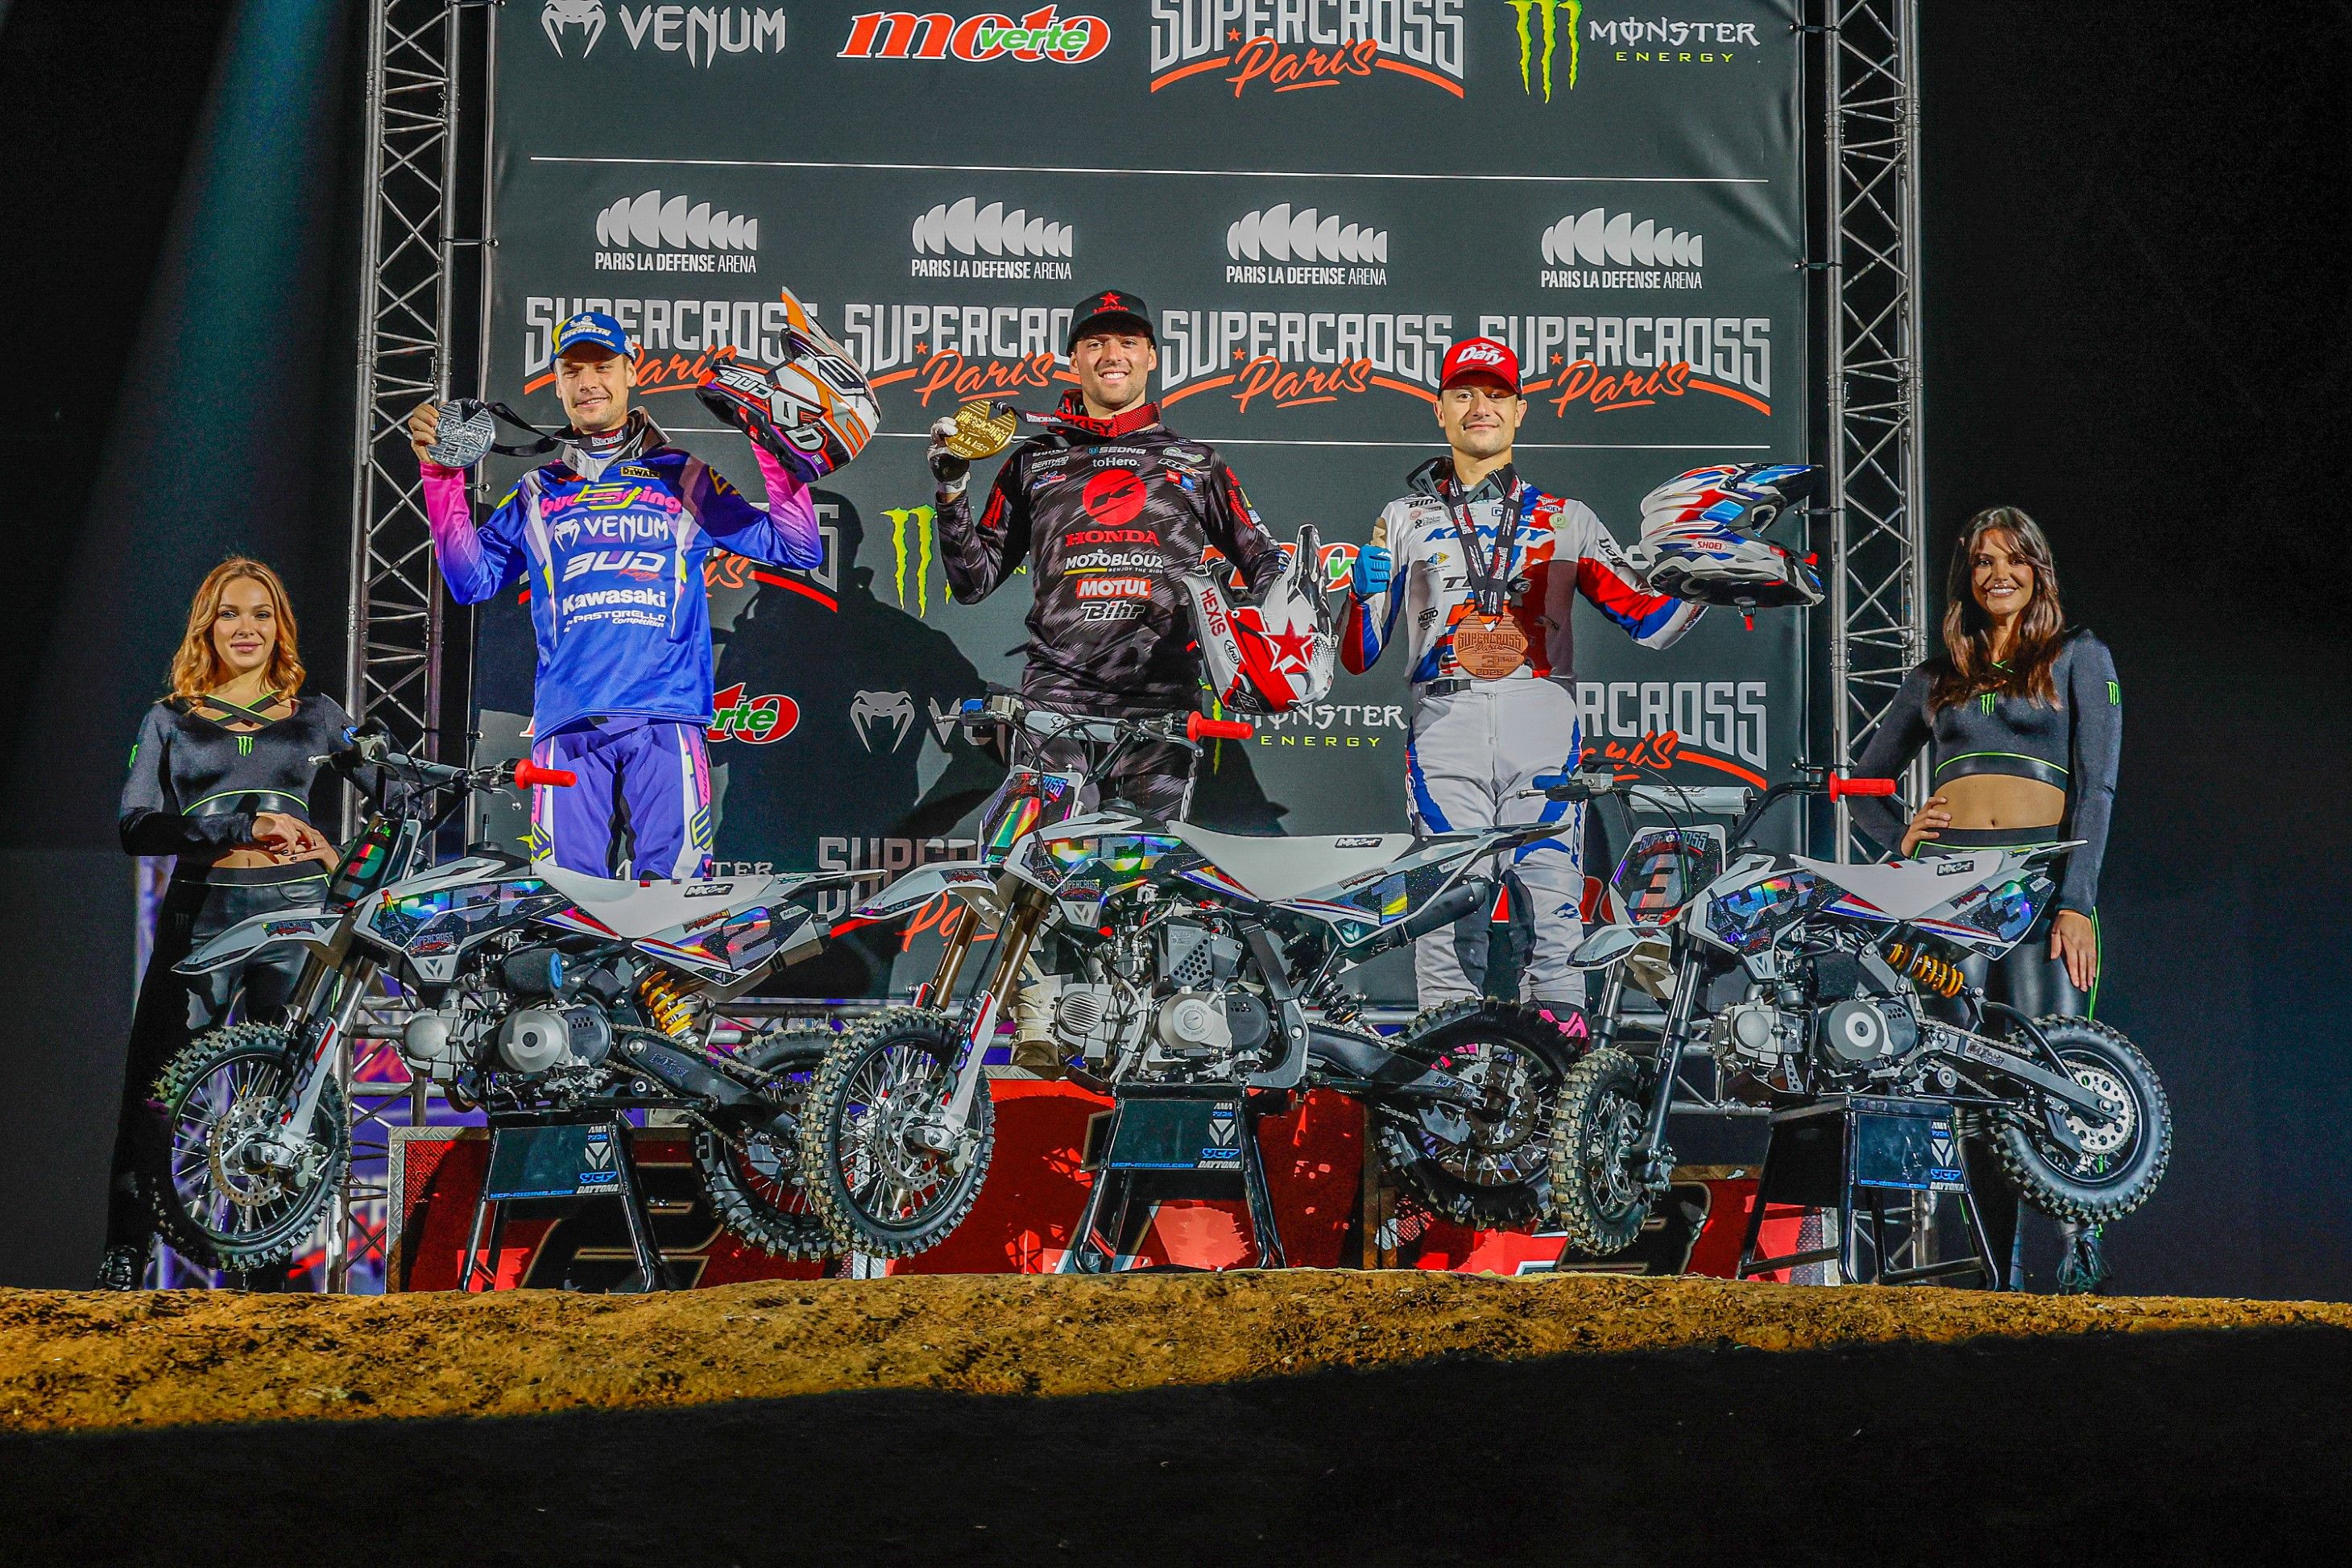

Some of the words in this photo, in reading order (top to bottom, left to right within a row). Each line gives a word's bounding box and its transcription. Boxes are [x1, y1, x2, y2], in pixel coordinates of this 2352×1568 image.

[619, 4, 786, 69] VENUM
[836, 4, 1112, 64] moto
[979, 25, 1089, 52] verte
[1150, 0, 1464, 80] SUPERCROSS
[1589, 16, 1762, 47] MONSTER
[1227, 36, 1377, 97] Paris
[1616, 52, 1733, 64] ENERGY
[594, 252, 635, 271] PARIS
[637, 253, 654, 271] LA
[656, 253, 715, 272] DEFENSE
[717, 254, 757, 274] ARENA
[911, 259, 951, 277] PARIS
[954, 259, 970, 278] LA
[972, 260, 1031, 279] DEFENSE
[1033, 262, 1072, 280] ARENA
[1226, 265, 1266, 283] PARIS
[1268, 266, 1285, 284] LA
[1287, 267, 1346, 285] DEFENSE
[1348, 267, 1387, 286] ARENA
[1541, 270, 1581, 288] PARIS
[1583, 271, 1600, 289] LA
[1602, 271, 1662, 289] DEFENSE
[1663, 271, 1703, 290] ARENA
[525, 296, 818, 379] SERCROS
[844, 304, 1078, 376] SUPERCRO
[1162, 310, 1452, 391] SUPERCROSS
[1456, 345, 1505, 365] Dafy
[915, 351, 1054, 407] Paris
[1232, 357, 1375, 414] Paris
[1551, 361, 1692, 419] Paris
[1092, 457, 1141, 468] toHero.
[584, 515, 669, 544] VENUM
[1065, 529, 1161, 547] HONDA
[1696, 540, 1723, 552] SHOEI
[562, 550, 667, 582] BUD
[1065, 548, 1164, 569] MOTOBLOUZ
[1078, 579, 1149, 597] MOTUL
[562, 587, 667, 616] Kawasaki
[1080, 601, 1145, 622] Bihr
[1199, 587, 1227, 637] HEXIS
[573, 610, 667, 625] PASTORELLO
[1458, 632, 1524, 650] SUPERCROSS
[1227, 645, 1239, 664] Arai
[1476, 668, 1504, 676] 2025
[1576, 681, 1767, 772] RCROSS
[1260, 734, 1381, 747] ENERGY
[1627, 853, 1695, 911] 3
[1371, 871, 1409, 925] 1
[723, 905, 776, 971] 2
[1203, 1148, 1240, 1159] YCF
[1197, 1160, 1240, 1169] DAYTONA
[1930, 1169, 1961, 1181] YCF
[579, 1171, 618, 1184] YCF
[1929, 1181, 1965, 1191] DAYTONA
[576, 1184, 620, 1194] DAYTONA
